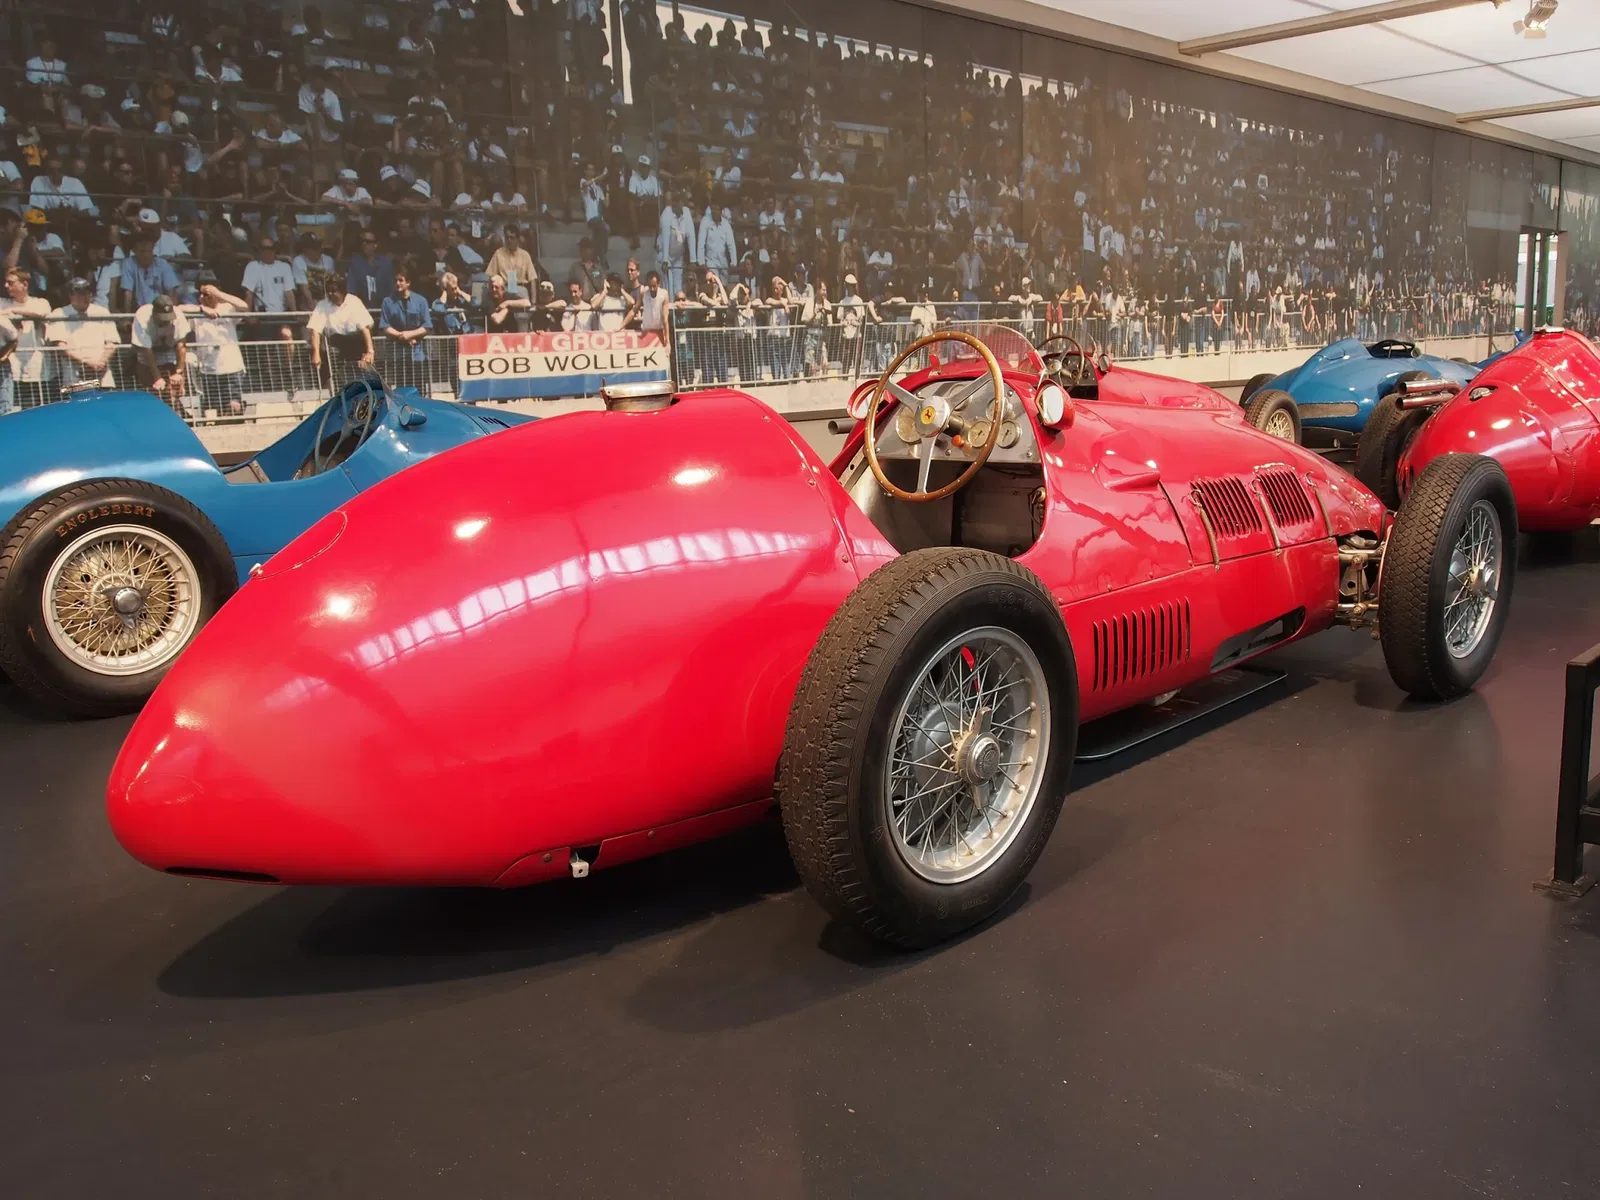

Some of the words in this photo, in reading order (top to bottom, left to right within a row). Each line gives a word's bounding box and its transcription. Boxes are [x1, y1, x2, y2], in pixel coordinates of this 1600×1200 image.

[487, 335, 539, 353] A.J.
[551, 331, 642, 351] GROET
[466, 356, 531, 376] BOB
[544, 350, 658, 372] WOLLEK
[55, 504, 156, 537] ENGLEBERT
